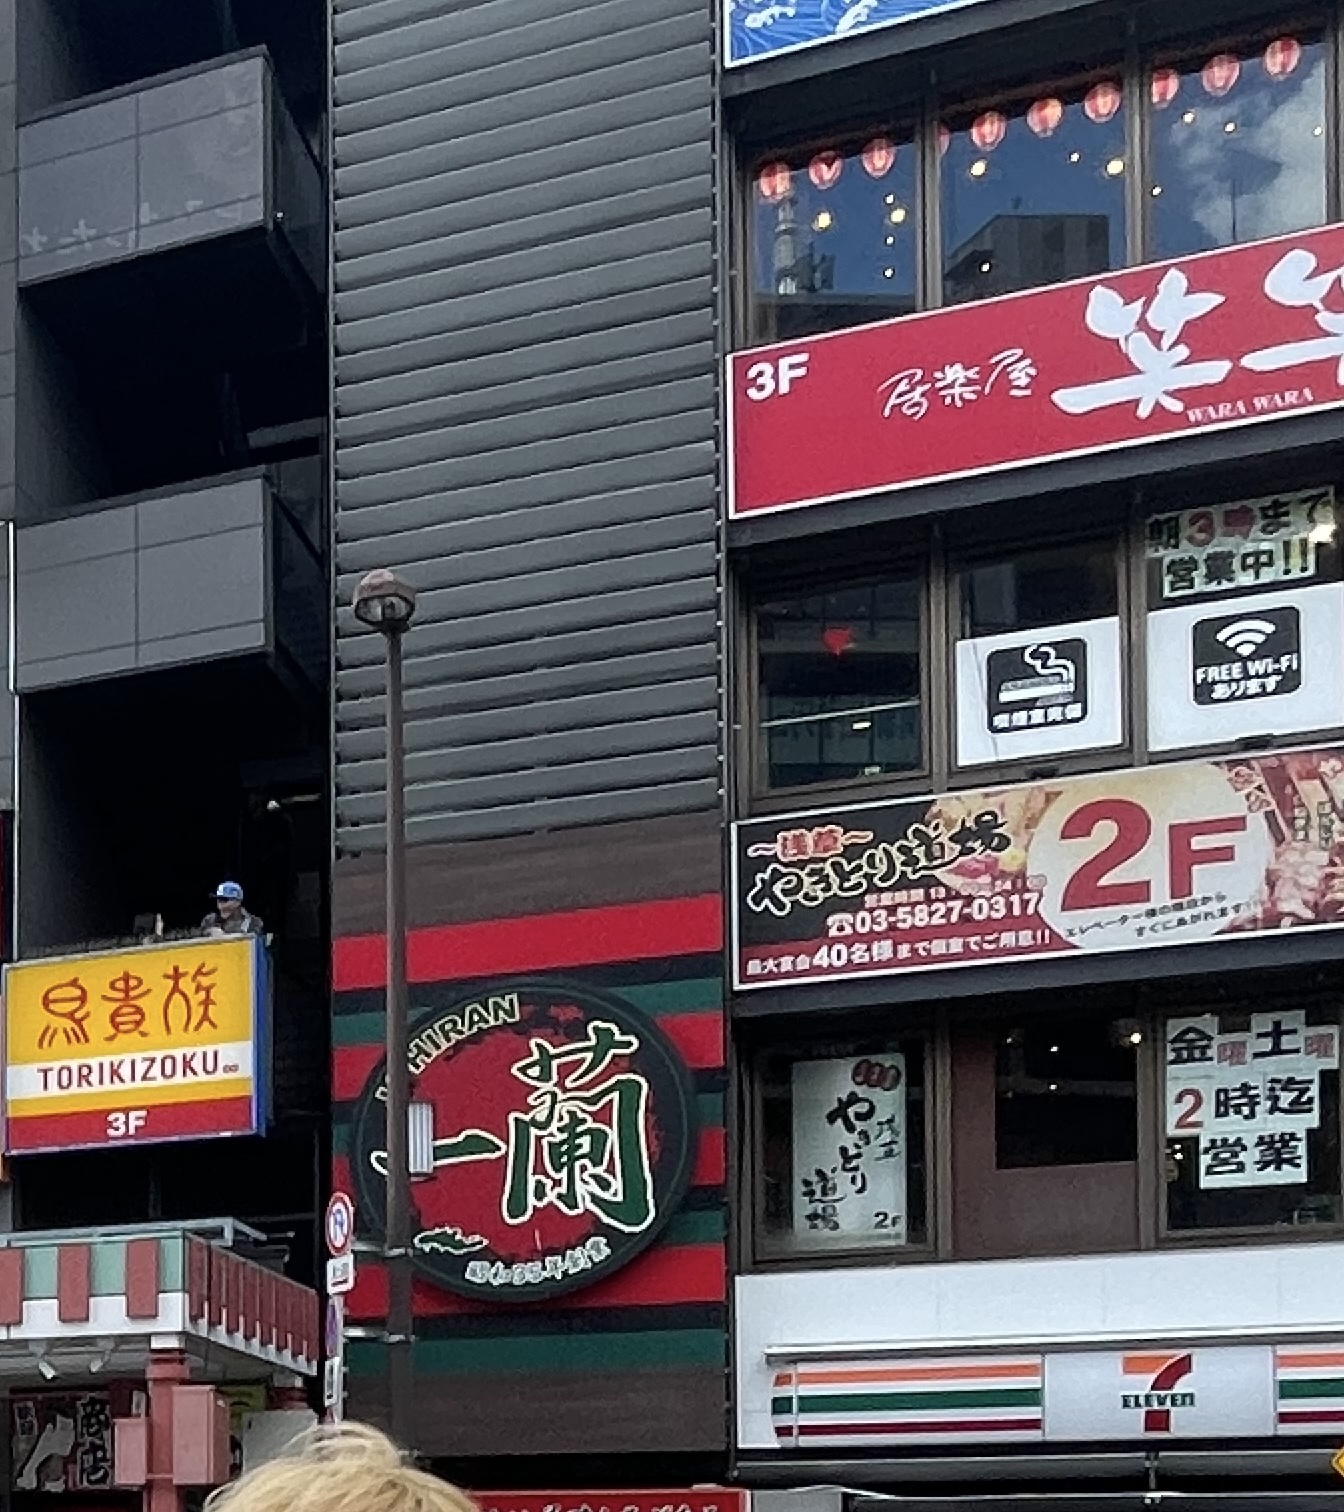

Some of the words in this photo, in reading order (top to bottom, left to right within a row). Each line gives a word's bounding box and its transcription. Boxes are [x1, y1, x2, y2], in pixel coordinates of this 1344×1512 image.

[745, 353, 810, 401] 3F
[1187, 404, 1247, 426] WARA
[1253, 387, 1314, 413] WARA
[1195, 661, 1244, 685] FREE
[1060, 797, 1248, 913] 2F
[854, 892, 1041, 934] 03-5827-0317
[37, 962, 218, 1050] 鳥貴族
[374, 992, 519, 1101] HIRAN
[37, 1049, 219, 1092] TORIKIZOKU
[106, 1110, 148, 1137] 3F
[1174, 1076, 1315, 1130] 2時迄
[1202, 1132, 1304, 1177] 営業
